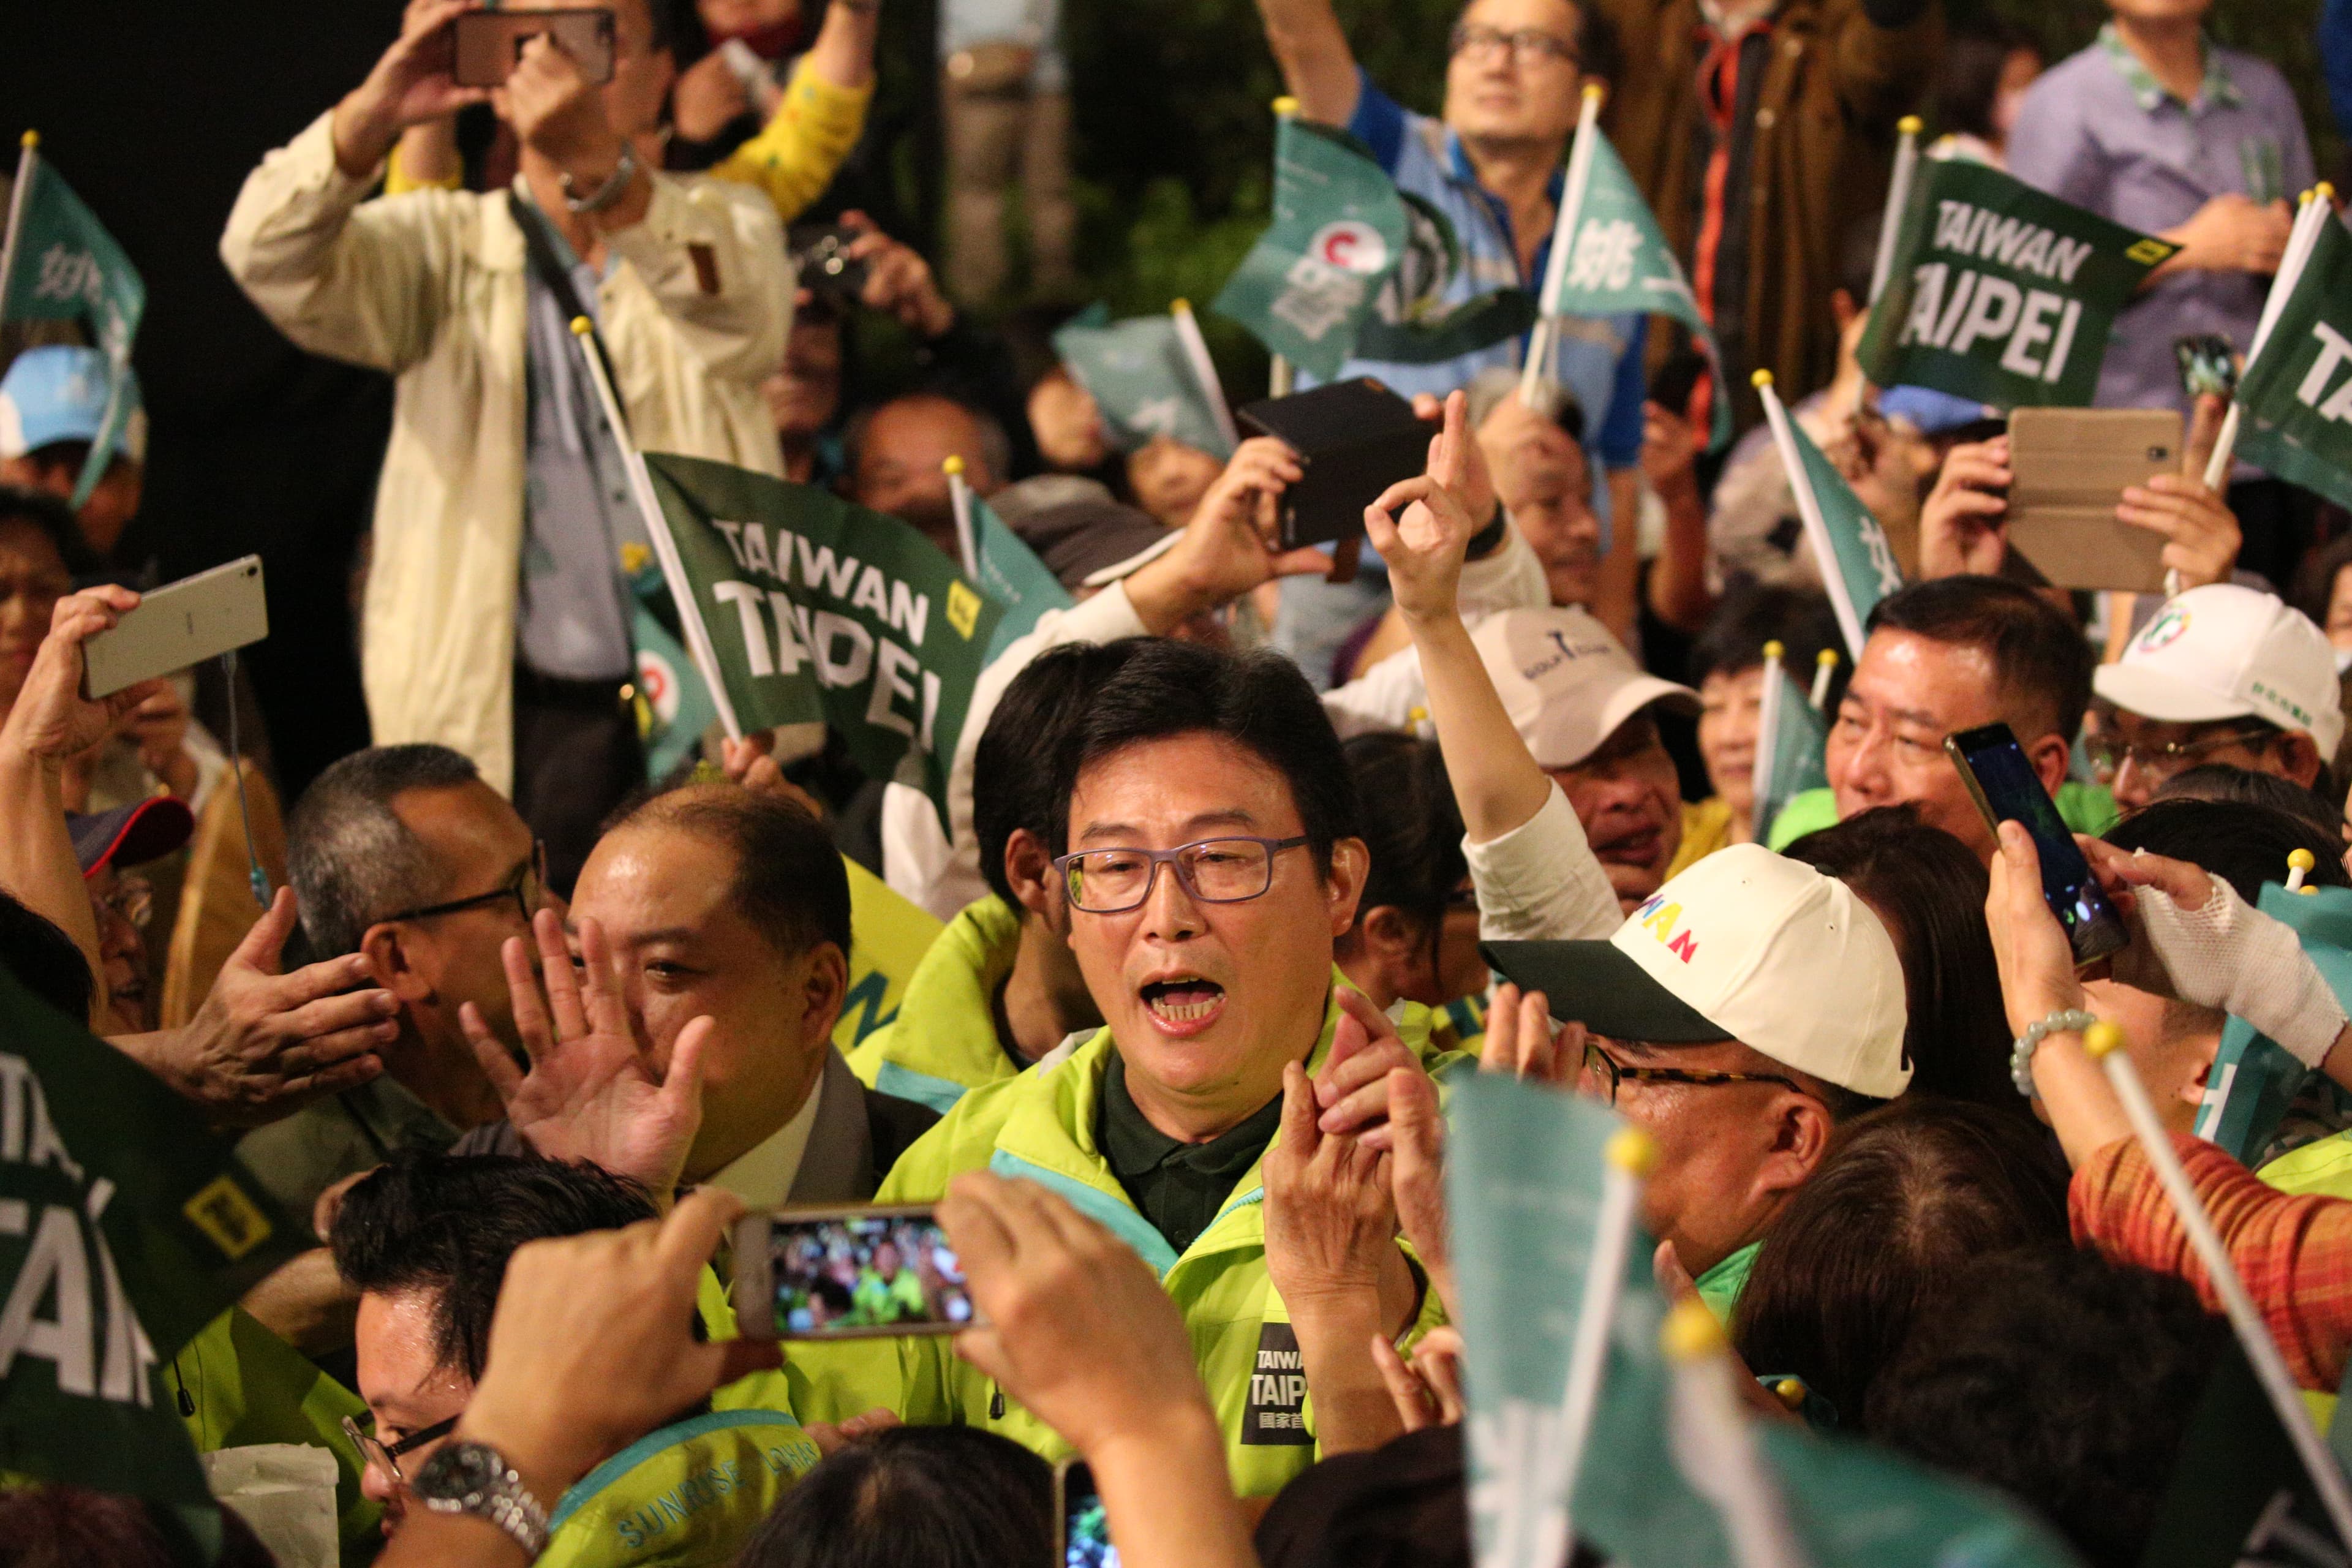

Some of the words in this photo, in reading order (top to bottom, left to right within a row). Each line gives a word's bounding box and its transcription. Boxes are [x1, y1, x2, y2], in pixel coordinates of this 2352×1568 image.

[1934, 198, 2094, 284] TAIWAN
[712, 519, 930, 647] TAIWAN
[617, 1460, 746, 1548] SUNRISE
